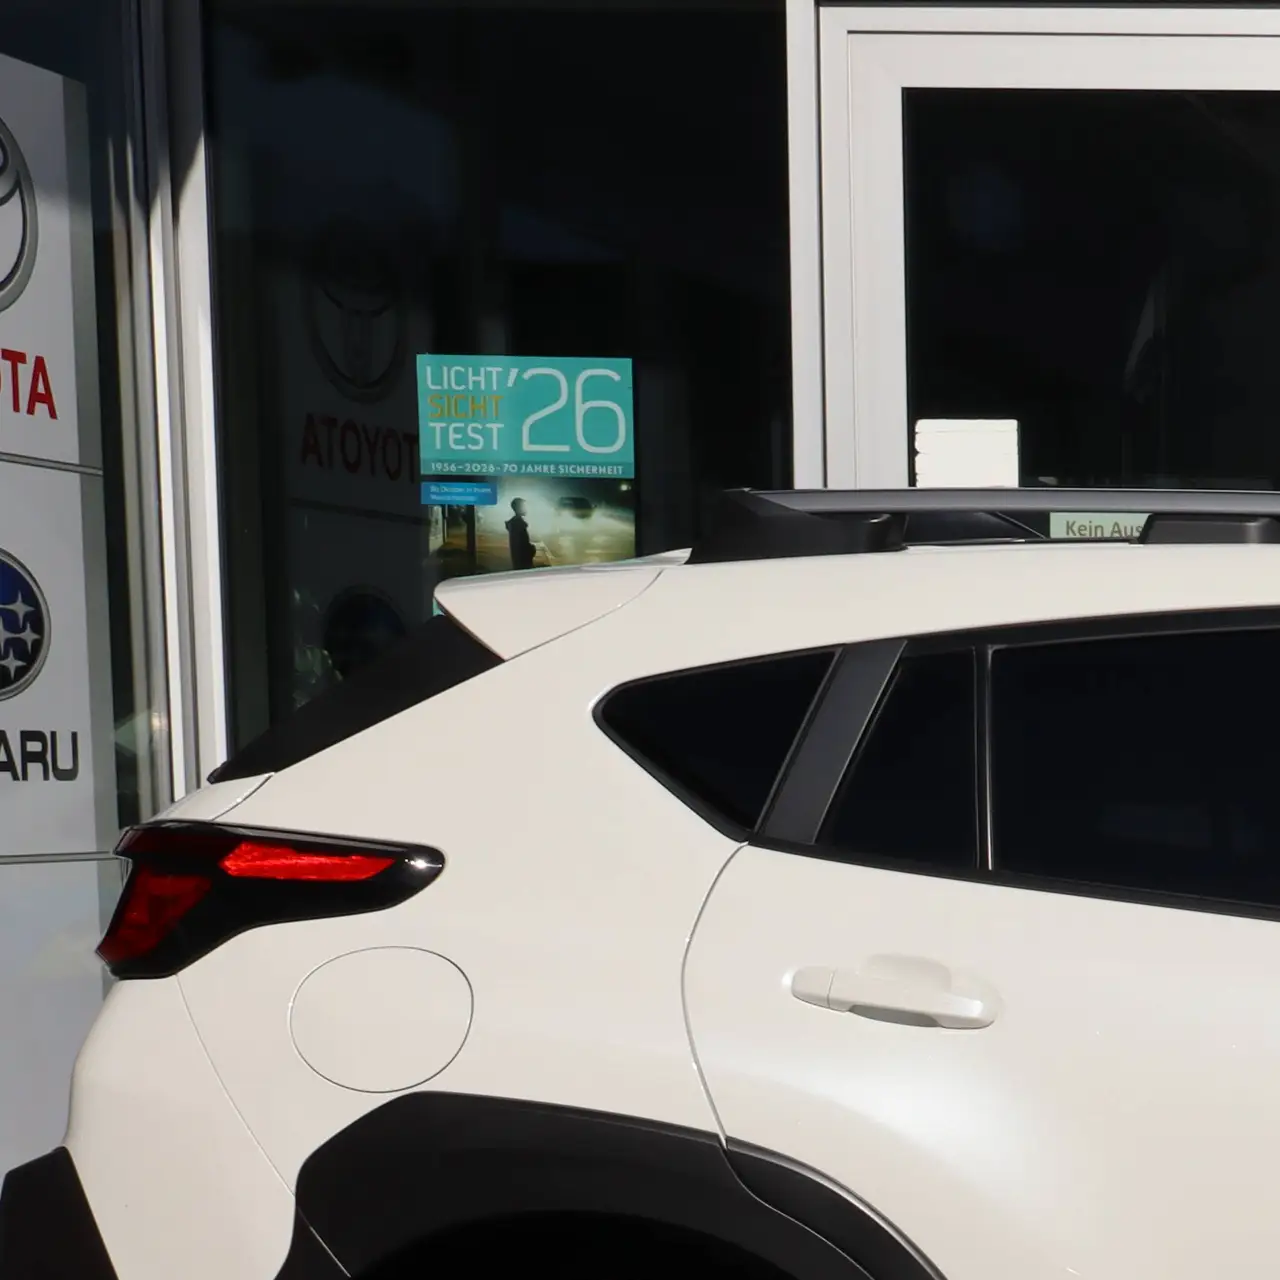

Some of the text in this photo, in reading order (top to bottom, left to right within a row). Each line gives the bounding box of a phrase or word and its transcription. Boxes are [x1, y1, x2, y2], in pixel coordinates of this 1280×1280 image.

[0, 348, 58, 420] TA
[425, 365, 503, 391] LICHT
[428, 395, 504, 419] SICHT
[429, 422, 504, 450] TEST
[520, 463, 556, 474] JAHRE
[558, 464, 624, 475] SICHERHEIT
[1065, 520, 1104, 537] Kein
